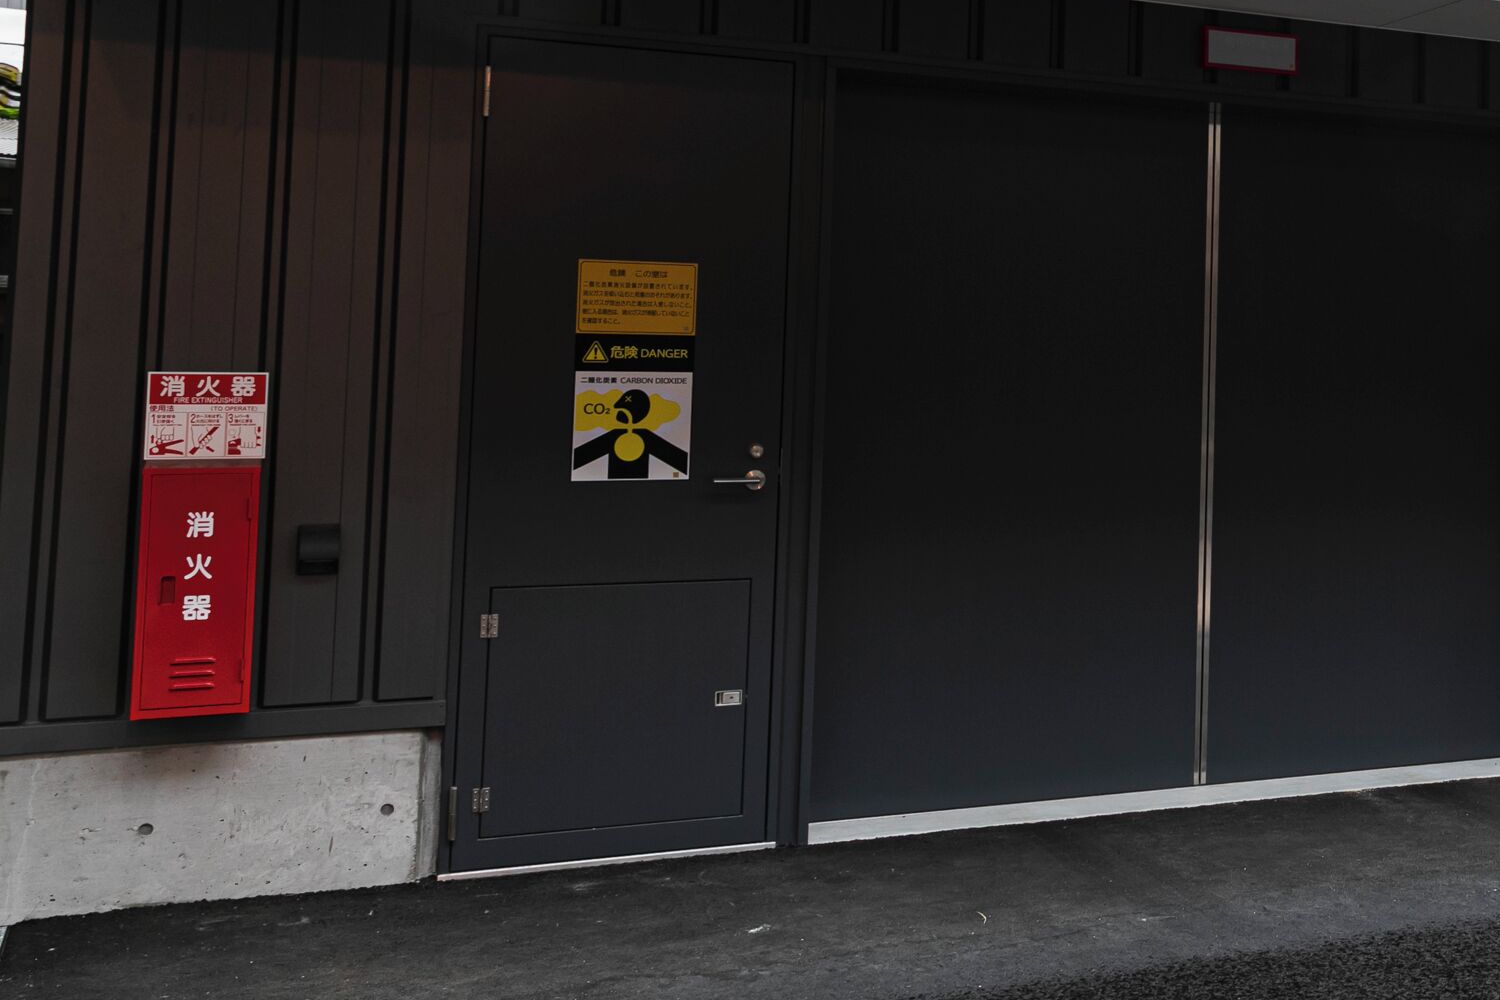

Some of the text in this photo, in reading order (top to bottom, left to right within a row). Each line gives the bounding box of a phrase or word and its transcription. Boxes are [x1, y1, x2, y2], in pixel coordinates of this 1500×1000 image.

[610, 345, 688, 359] 危険 DANGER
[160, 375, 257, 397] 消火器
[190, 413, 197, 424] 2
[228, 413, 234, 424] 3
[181, 511, 215, 621] 消火器
